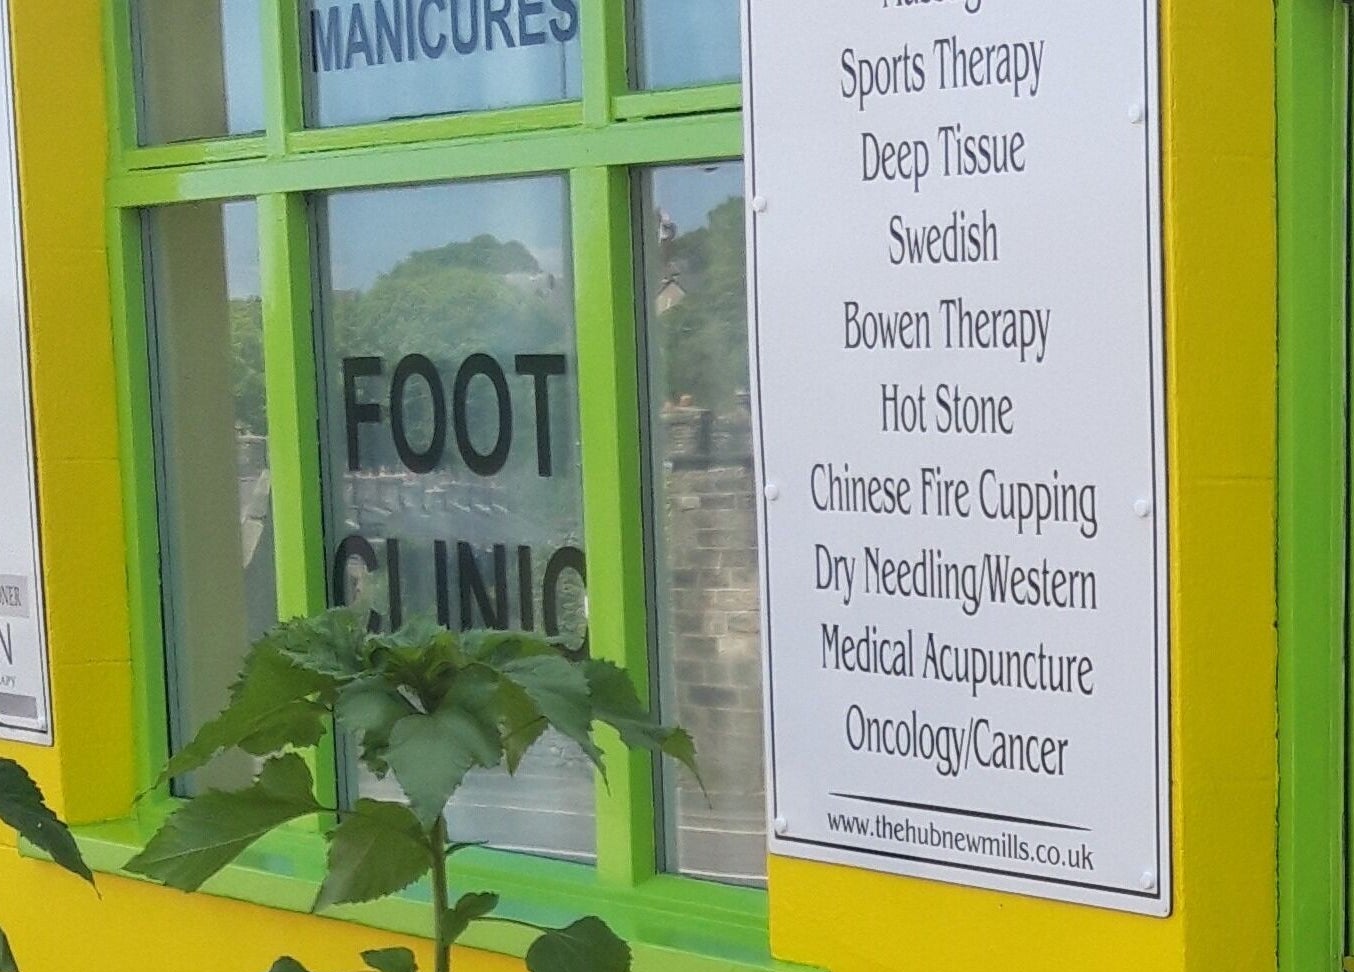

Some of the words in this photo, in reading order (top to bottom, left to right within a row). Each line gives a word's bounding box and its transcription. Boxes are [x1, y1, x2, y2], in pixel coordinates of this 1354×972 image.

[311, 0, 579, 72] MANICURES
[841, 44, 925, 111] Sports
[933, 35, 1045, 97] Therapy
[861, 132, 930, 192] Deep
[938, 123, 1026, 177] Tissue
[889, 209, 999, 265] Swedish
[843, 301, 931, 350] Bowen
[940, 297, 1051, 363] Therapy
[342, 353, 568, 478] FOOT
[880, 384, 927, 433] Hot
[935, 383, 1014, 434] Stone
[810, 463, 912, 516] Chinese
[920, 466, 971, 518] Fire
[979, 469, 1098, 538] Cupping
[815, 544, 856, 605] Dry
[864, 547, 1097, 616] Needling/Western
[821, 622, 914, 678] Medical
[922, 632, 1094, 697] Acupuncture
[845, 704, 1069, 777] Oncology/Cancer
[827, 811, 1095, 871] www.thehubnewmills.co.uk
